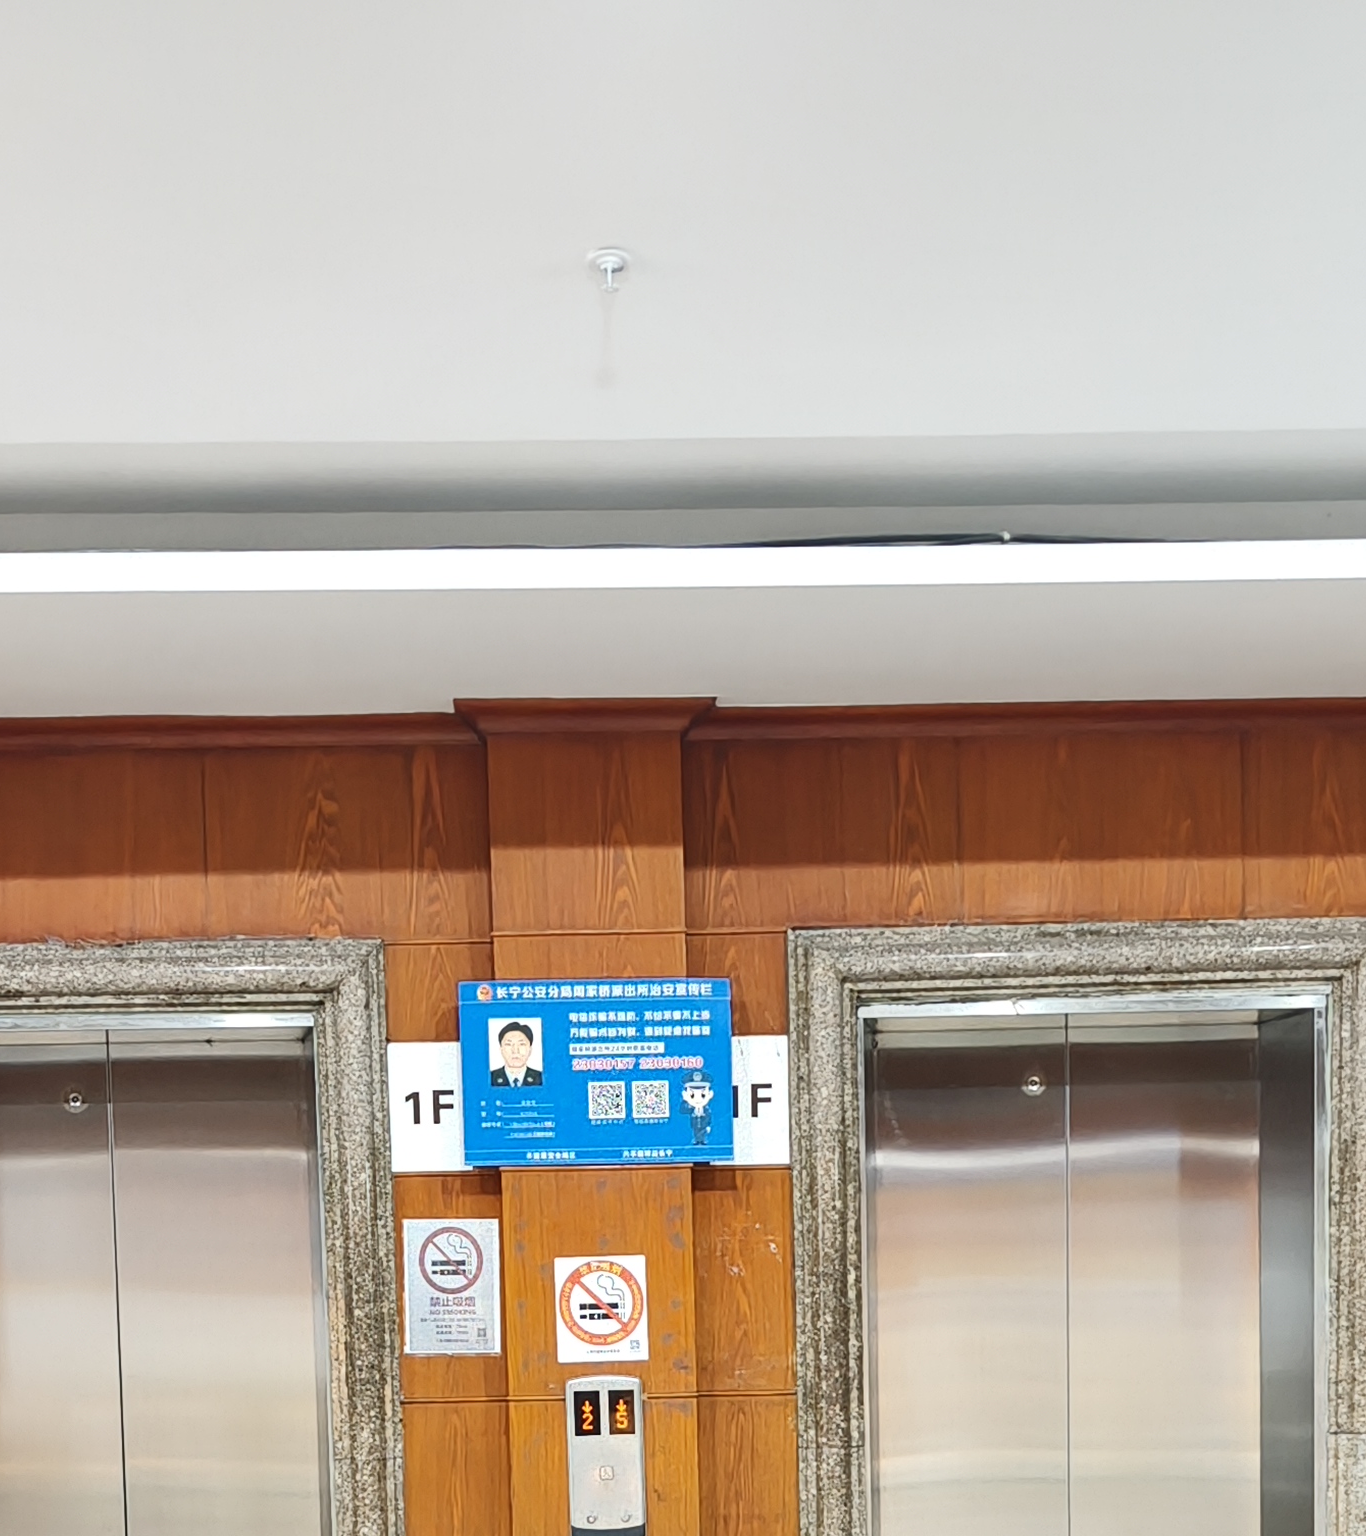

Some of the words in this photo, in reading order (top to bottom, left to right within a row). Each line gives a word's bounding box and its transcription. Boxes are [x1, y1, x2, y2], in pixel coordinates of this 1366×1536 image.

[404, 1089, 455, 1125] 1F
[429, 1296, 476, 1308] 禁止吸烟
[581, 1412, 594, 1431] 2
[615, 1412, 628, 1430] 5
